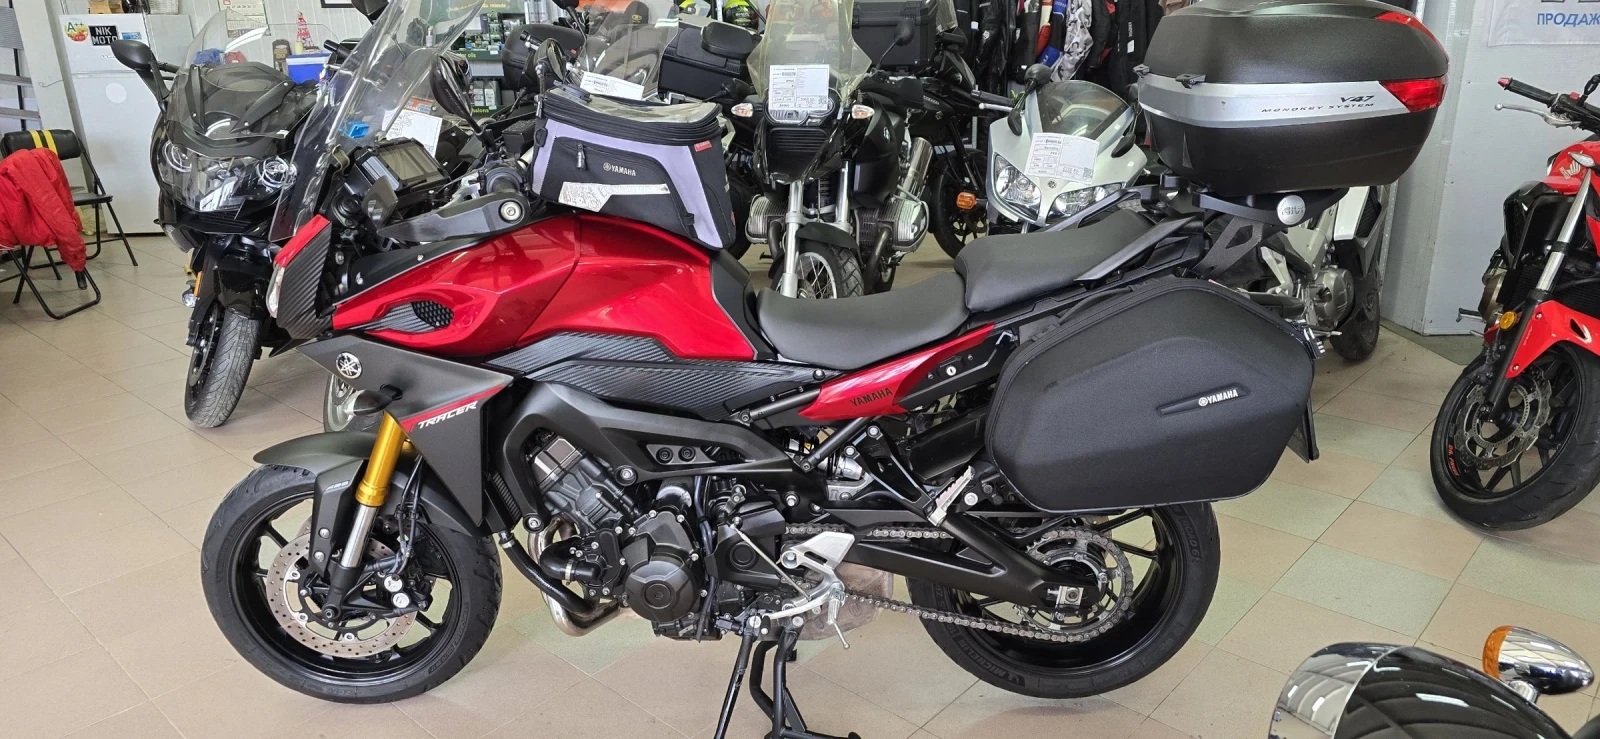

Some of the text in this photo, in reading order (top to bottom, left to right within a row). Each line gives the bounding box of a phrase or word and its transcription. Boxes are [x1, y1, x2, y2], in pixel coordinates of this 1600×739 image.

[1536, 12, 1600, 28] ПРОДАЖ
[95, 26, 112, 36] NIK
[1340, 95, 1375, 103] V47
[1261, 105, 1323, 113] MONOKEY
[611, 165, 636, 176] YAMAHA
[850, 387, 893, 407] YAMAHA
[1207, 389, 1239, 404] YAMAHA
[417, 400, 479, 429] TRACER
[956, 638, 1009, 679] MICHELIN
